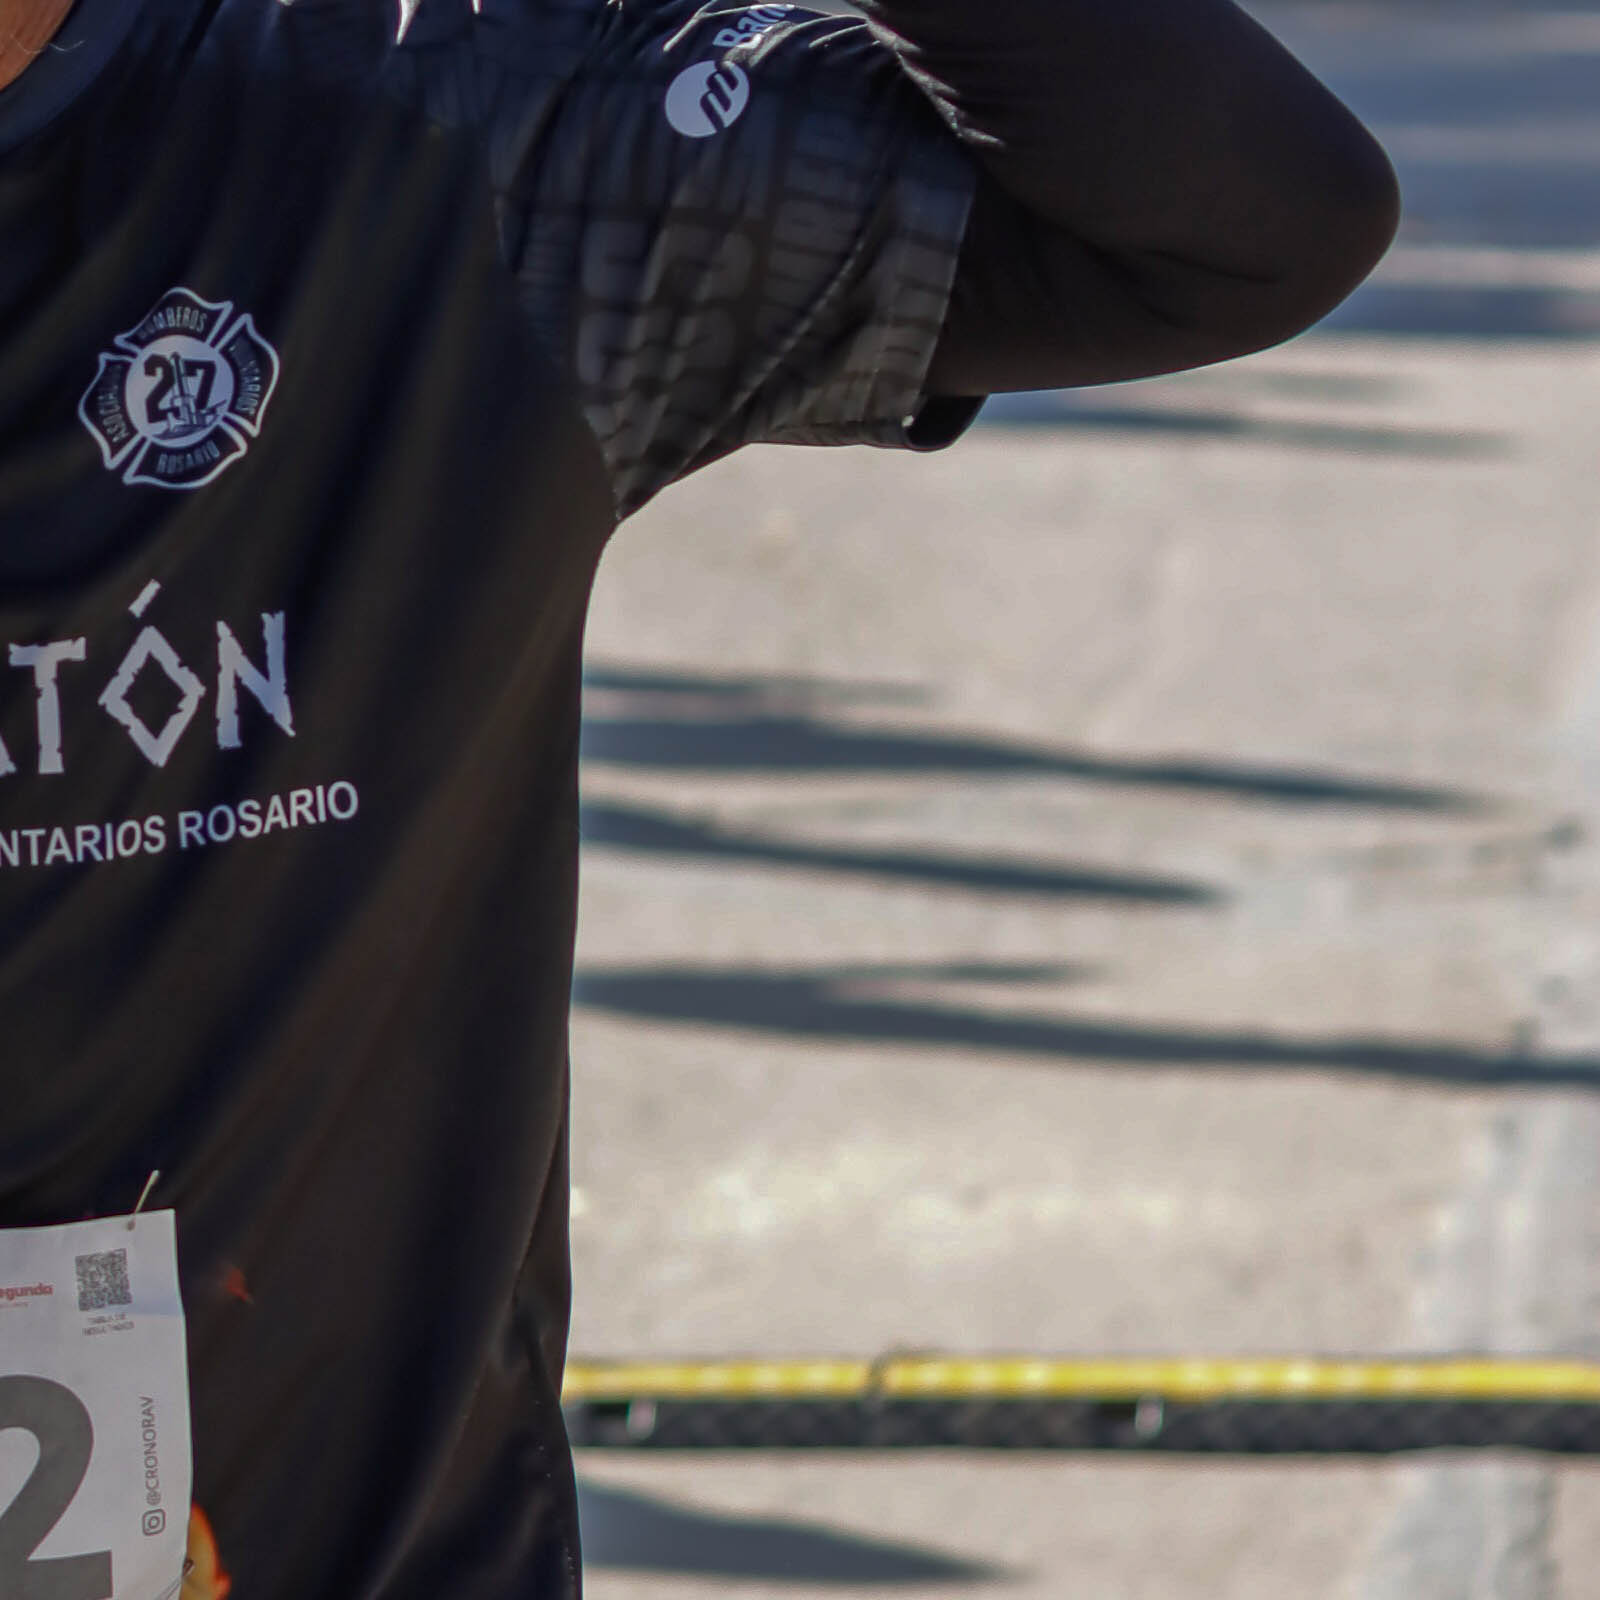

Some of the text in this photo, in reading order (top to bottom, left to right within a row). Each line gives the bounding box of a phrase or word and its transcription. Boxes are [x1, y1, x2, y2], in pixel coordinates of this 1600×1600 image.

[144, 353, 218, 424] 27
[178, 780, 359, 850] ROSARIO
[138, 1395, 162, 1506] @CRONORAV
